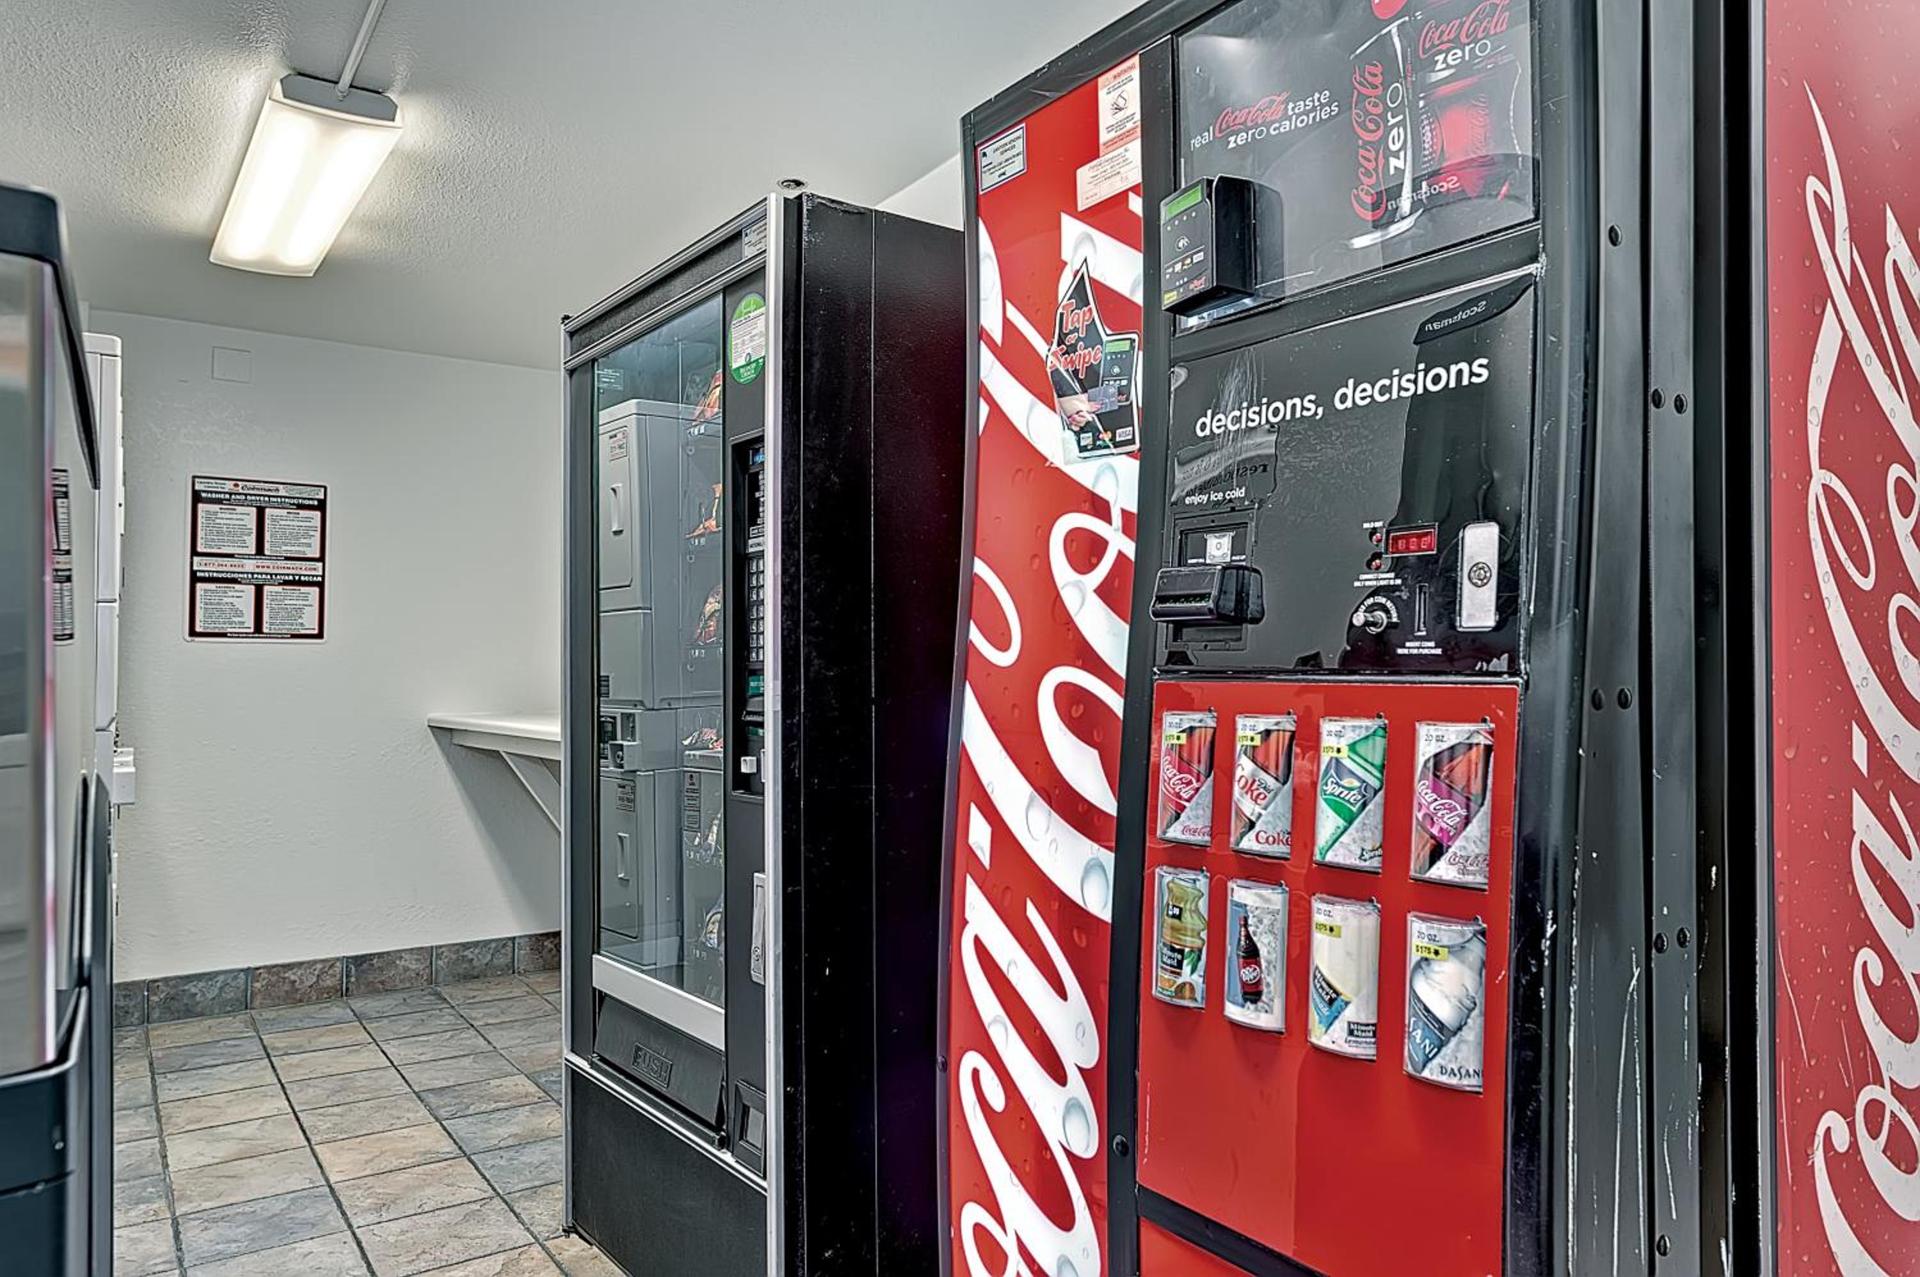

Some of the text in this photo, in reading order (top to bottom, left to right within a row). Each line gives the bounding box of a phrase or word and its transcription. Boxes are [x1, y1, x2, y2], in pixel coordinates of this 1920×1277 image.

[1434, 40, 1491, 71] zero
[1190, 126, 1213, 151] real
[1287, 90, 1330, 116] taste
[1227, 102, 1339, 149] zero calories
[1387, 82, 1405, 176] zero
[1351, 60, 1387, 221] Coca-Cola
[1061, 300, 1094, 337] Tap
[1050, 342, 1103, 379] Swipe
[1195, 357, 1489, 438] decisions, decisions
[269, 496, 318, 505] INSTRUCTIONS
[1185, 487, 1245, 505] enjoy ice cold
[1323, 778, 1361, 805] Sprite
[1255, 830, 1291, 846] Coke
